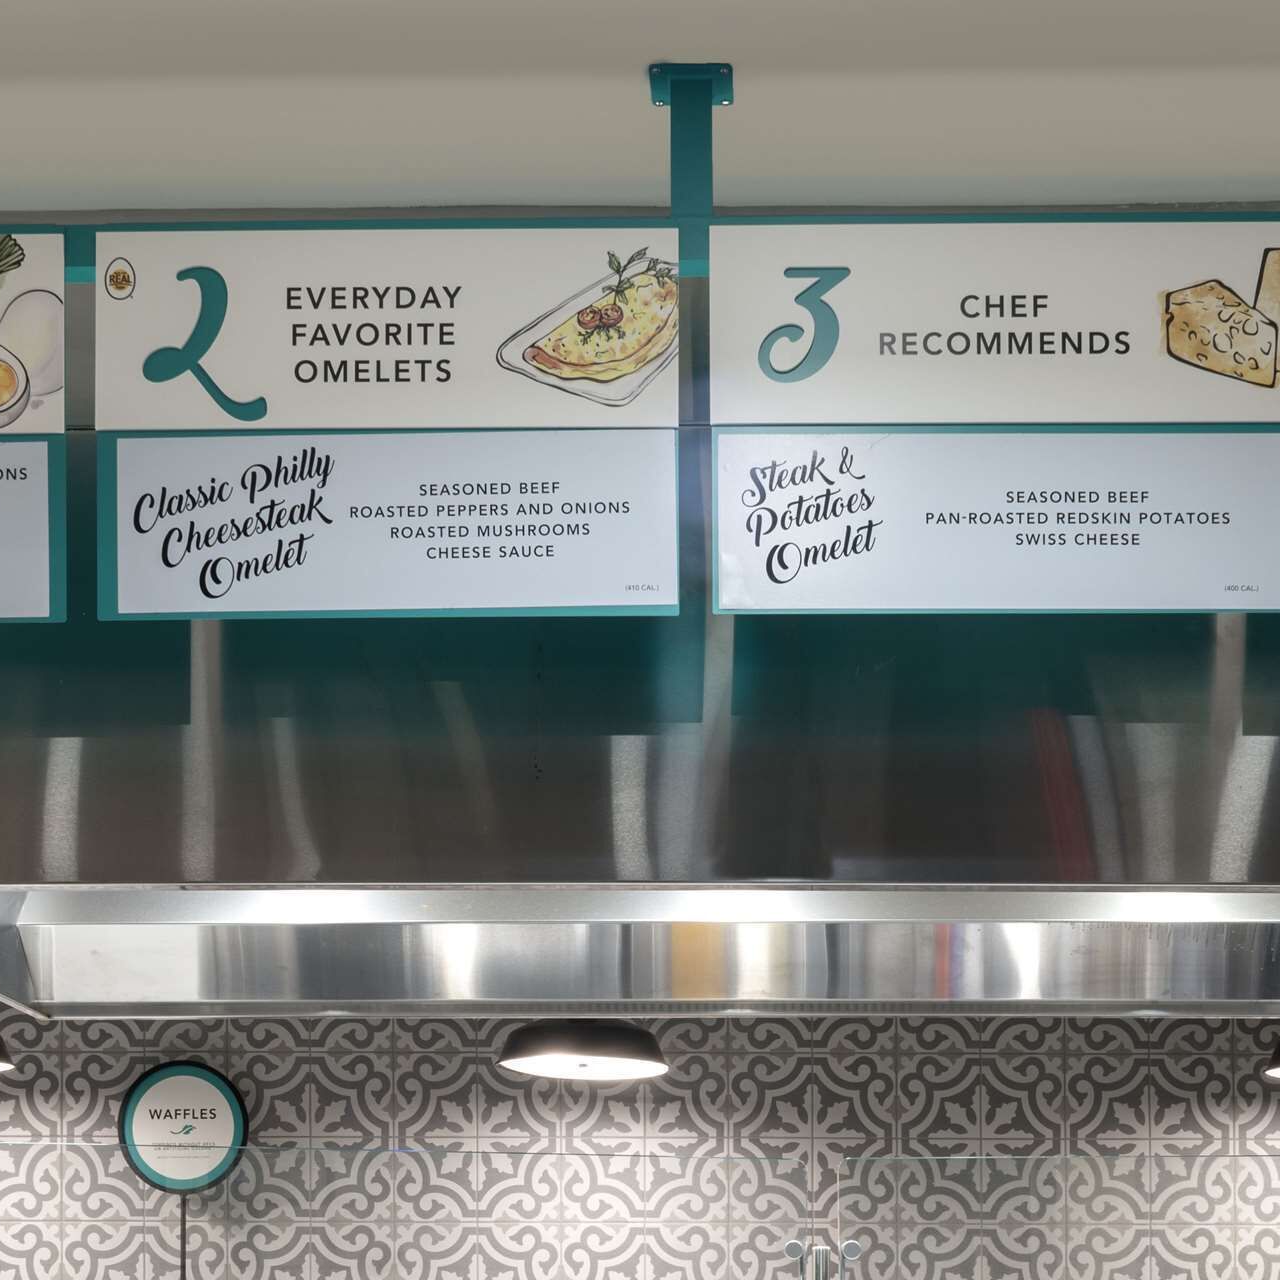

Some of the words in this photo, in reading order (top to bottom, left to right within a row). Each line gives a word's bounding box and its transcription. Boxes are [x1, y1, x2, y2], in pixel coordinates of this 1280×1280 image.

[108, 274, 132, 283] REAL
[286, 285, 462, 310] EVERYDAY
[959, 294, 1049, 319] CHEF
[291, 322, 456, 347] FAVORITE
[757, 265, 852, 384] 3
[142, 265, 268, 422] 2
[879, 330, 1131, 356] RECOMMENDS
[294, 358, 452, 384] OMELETS
[419, 482, 512, 497] SEASONED
[519, 481, 560, 495] BEEF
[741, 449, 836, 507] Steak
[838, 446, 866, 480] &
[133, 477, 234, 534] Classic
[240, 447, 335, 504] Philly
[1006, 490, 1100, 504] SEASONED
[1107, 490, 1149, 504] BEEF
[349, 505, 429, 519] ROASTED
[436, 503, 509, 517] PEPPERS
[515, 502, 554, 516] AND
[560, 500, 630, 515] ONIONS
[746, 488, 875, 547] Potatoes
[925, 511, 1049, 525] PAN-ROASTED
[1056, 511, 1131, 525] REDSKIN
[1139, 511, 1231, 525] POTATOES
[161, 488, 334, 568] Cheesesteak
[390, 525, 470, 539] ROASTED
[477, 522, 591, 537] MUSHROOMS
[1015, 532, 1067, 546] SWISS
[1074, 532, 1140, 546] CHEESE
[426, 546, 492, 560] CHEESE
[498, 544, 555, 559] SAUCE
[766, 520, 884, 584] Omelet
[199, 533, 315, 599] Omelet
[148, 1107, 217, 1120] WAFFLES
